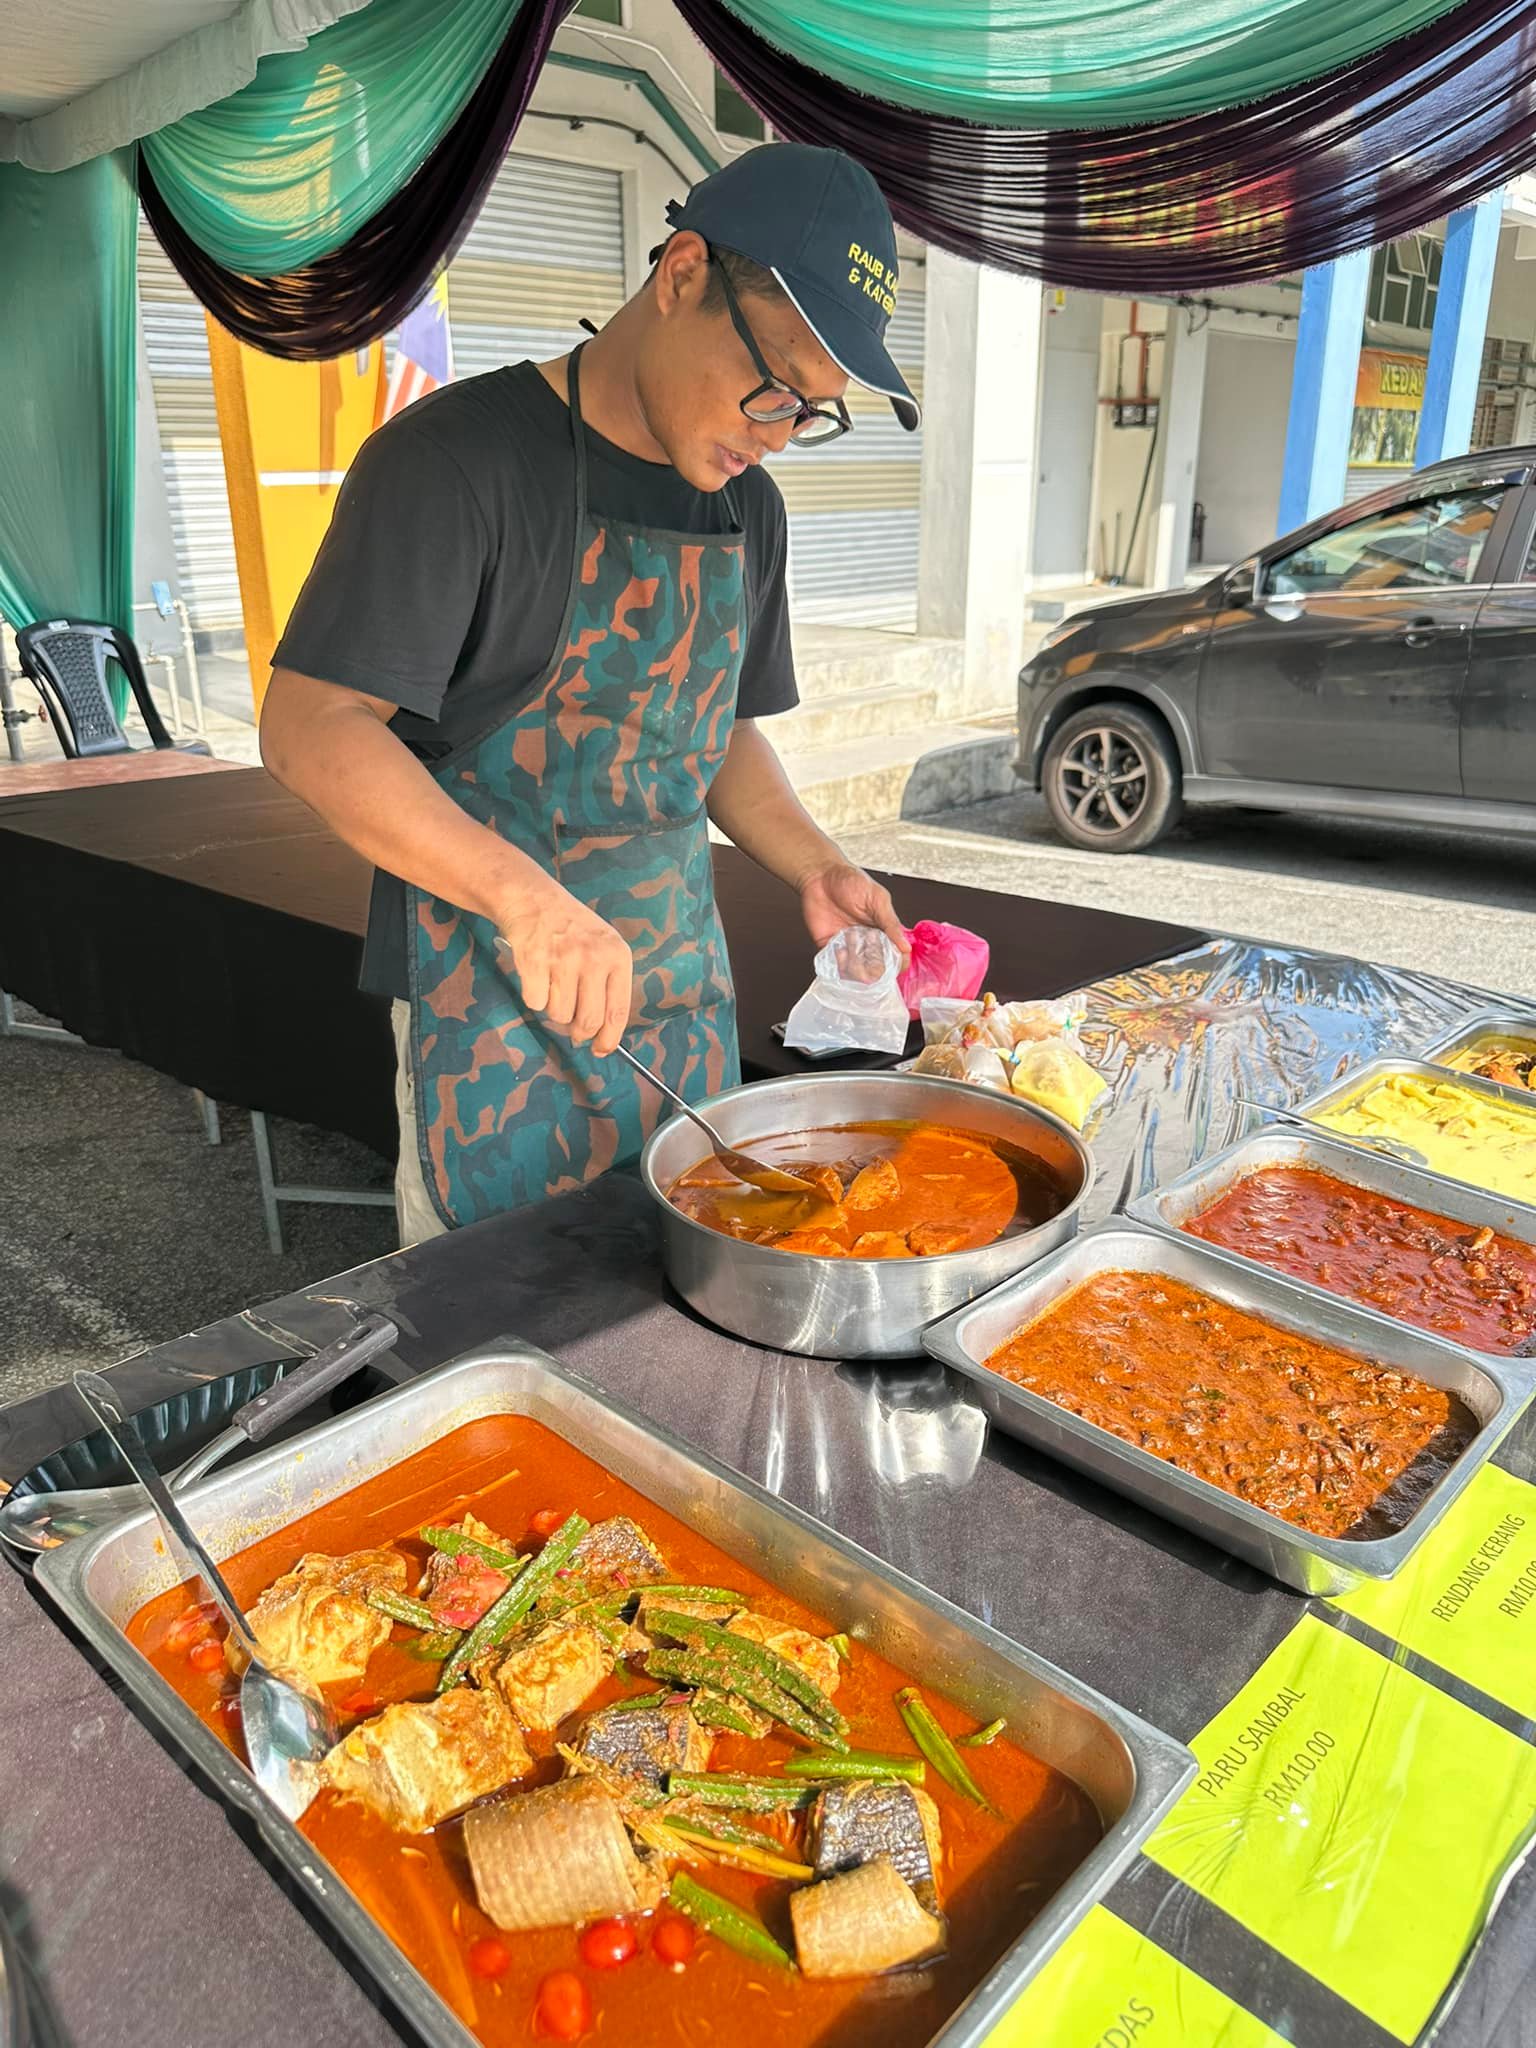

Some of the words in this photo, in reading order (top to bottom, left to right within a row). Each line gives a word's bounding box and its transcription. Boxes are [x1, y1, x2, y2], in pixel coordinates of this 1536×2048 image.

[848, 242, 884, 279] RAUB
[848, 267, 861, 284] &
[1431, 1557, 1491, 1622] RENDANG
[1477, 1513, 1526, 1561] KERANG
[1197, 1746, 1248, 1797] PARU
[1238, 1686, 1306, 1751] SAMBAL
[1264, 1731, 1336, 1808] RM10.00
[1096, 1997, 1154, 2048] DAS
